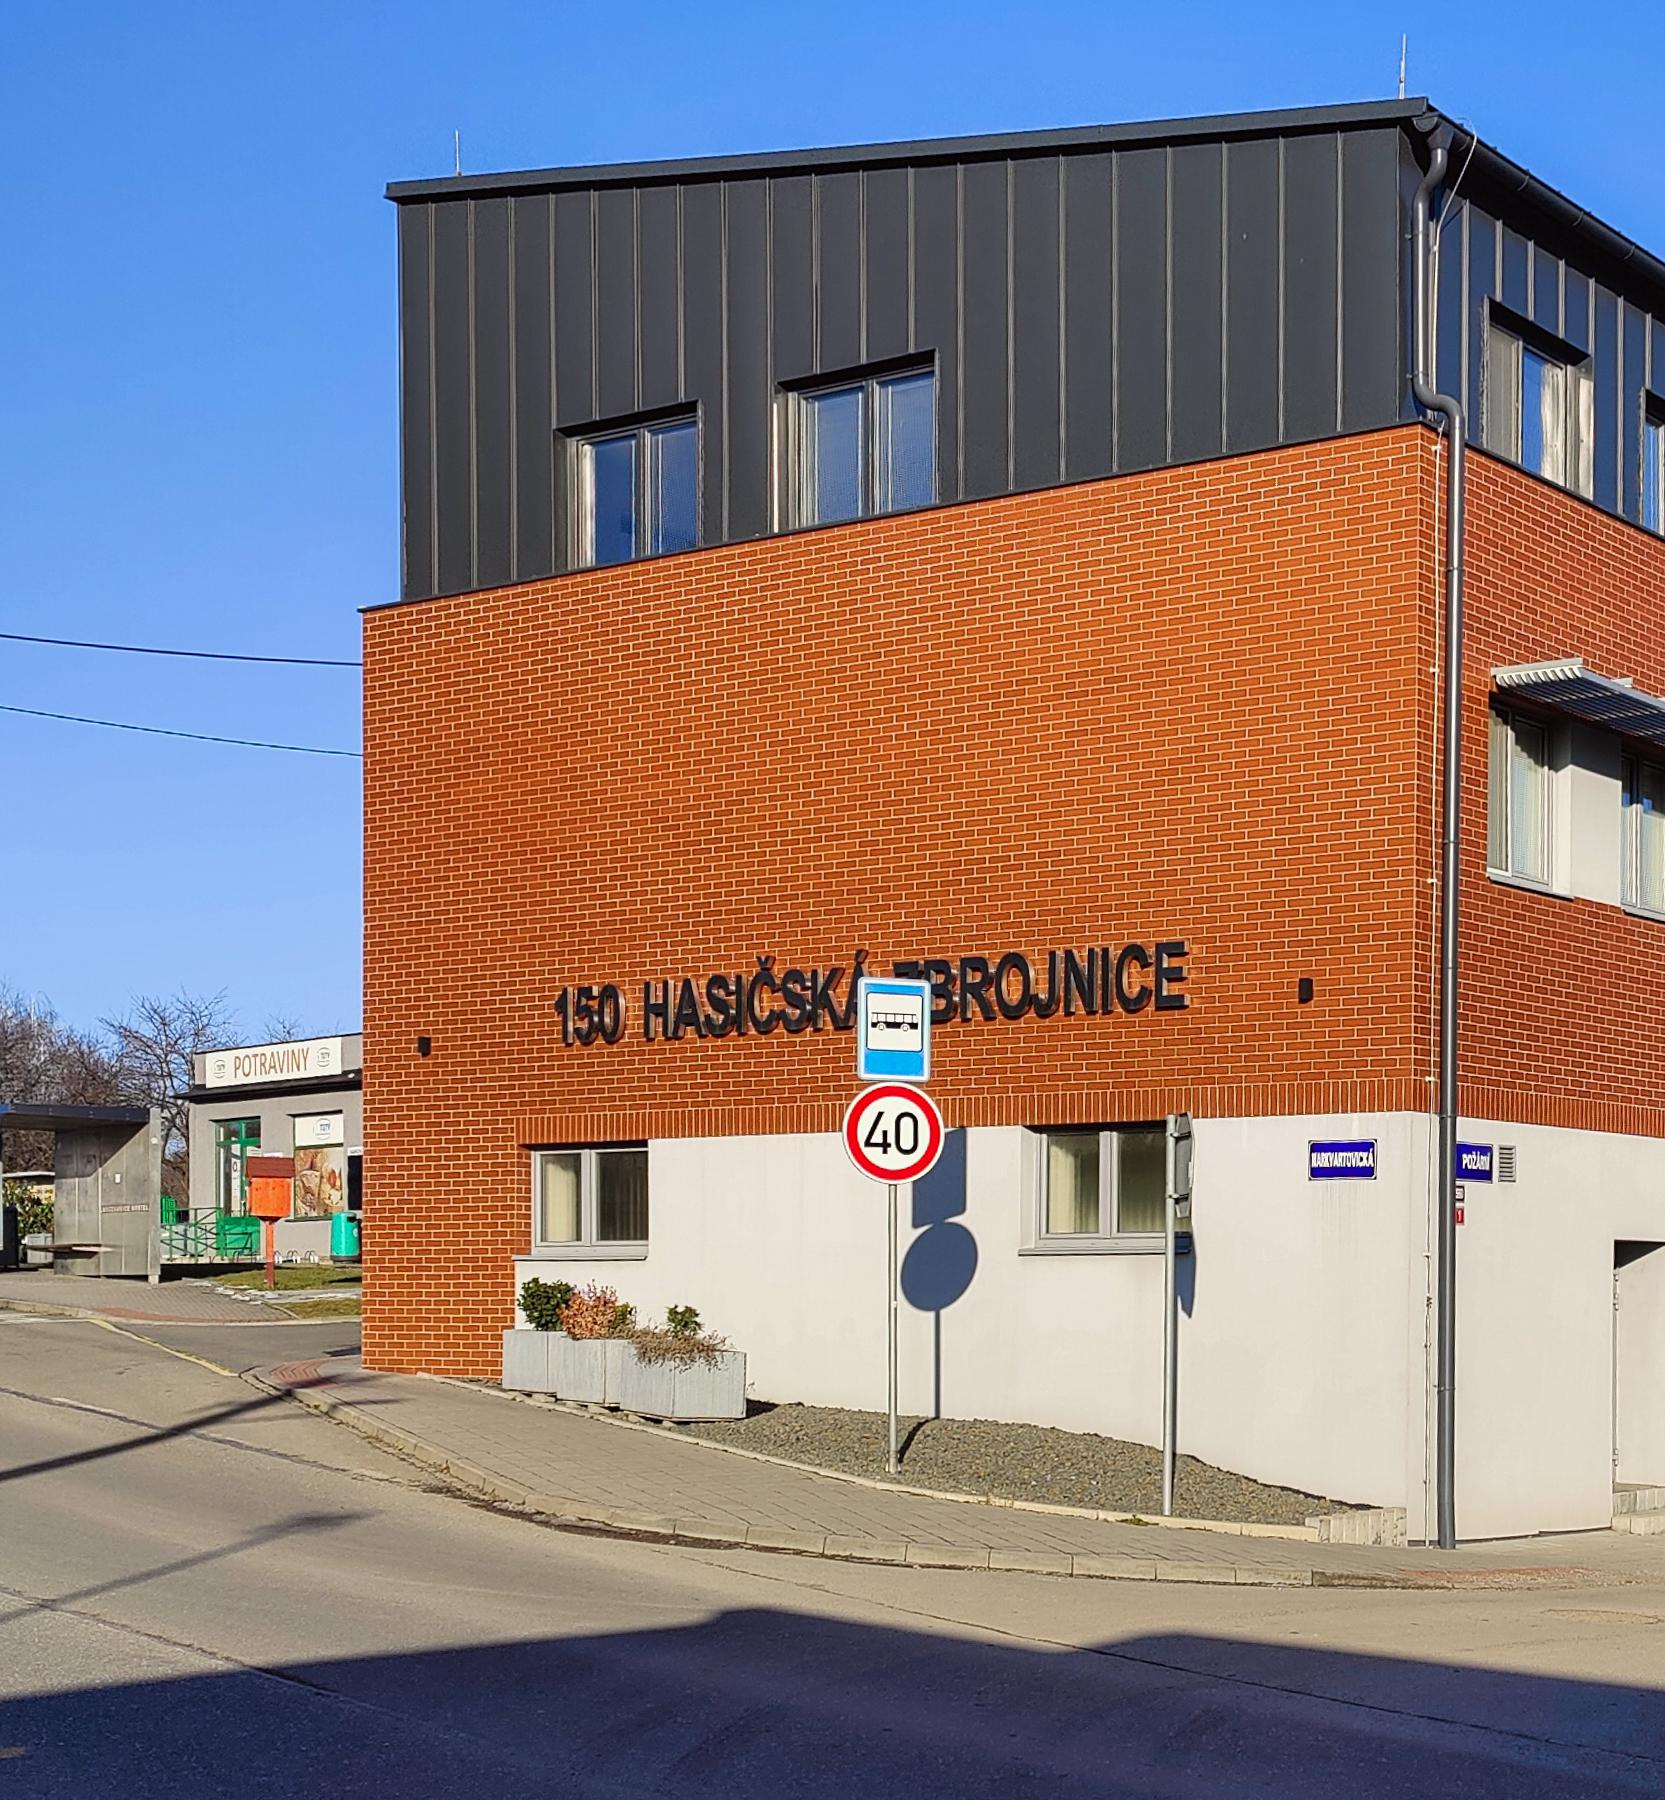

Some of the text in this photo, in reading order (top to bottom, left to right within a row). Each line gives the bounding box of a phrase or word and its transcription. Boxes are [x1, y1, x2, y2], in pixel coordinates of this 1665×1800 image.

[556, 983, 624, 1044] 150
[893, 941, 1189, 1024] BROJNICE
[233, 1047, 310, 1079] POTRAVINY
[864, 1111, 919, 1155] 40
